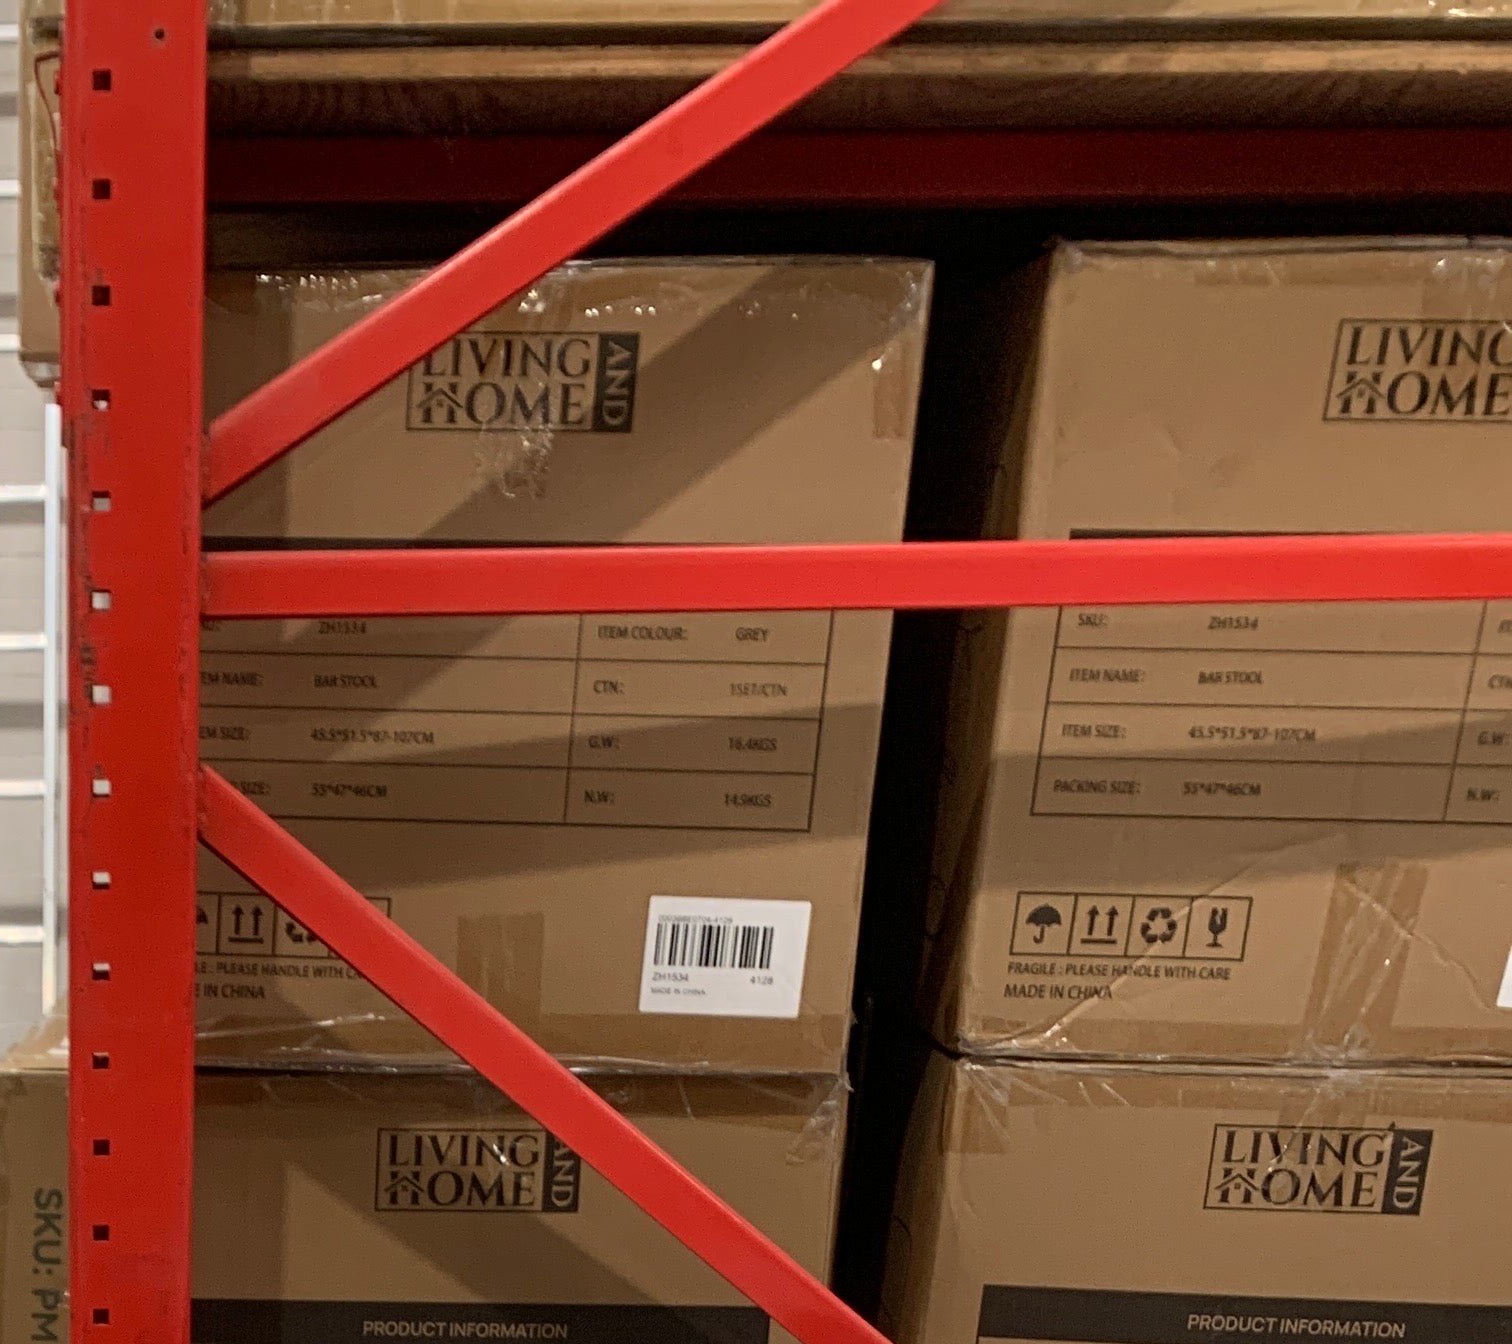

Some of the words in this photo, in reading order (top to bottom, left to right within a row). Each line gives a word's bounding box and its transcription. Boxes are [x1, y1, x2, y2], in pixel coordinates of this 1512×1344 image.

[422, 337, 591, 378] LIVING
[602, 340, 634, 427] AND
[1336, 370, 1512, 416] HOME
[417, 381, 586, 425] HOME
[735, 627, 769, 642] GREY
[216, 964, 259, 977] PLEASE
[261, 966, 311, 979] HANDLE
[312, 967, 345, 979] WITH
[1007, 961, 1056, 975] FRAGILE
[1065, 963, 1112, 977] PLEASE
[1164, 966, 1197, 979] WITH
[1198, 966, 1231, 981] CARE
[203, 984, 219, 999] IN
[221, 984, 266, 1000] CHINA
[1003, 983, 1045, 998] MADE
[1049, 984, 1064, 999] IN
[1067, 985, 1113, 1000] CHINA
[389, 1133, 539, 1169] LIVING
[1222, 1129, 1388, 1168] LIVING
[383, 1170, 537, 1207] HOME
[1214, 1167, 1379, 1208] HOME
[1392, 1136, 1426, 1210] AND
[31, 1187, 63, 1275] SKU:
[362, 1320, 447, 1337] PRODUCT
[448, 1321, 568, 1339] INFORMATION
[1187, 1314, 1278, 1333] PRODUCT
[1279, 1318, 1407, 1339] INFORMATION
